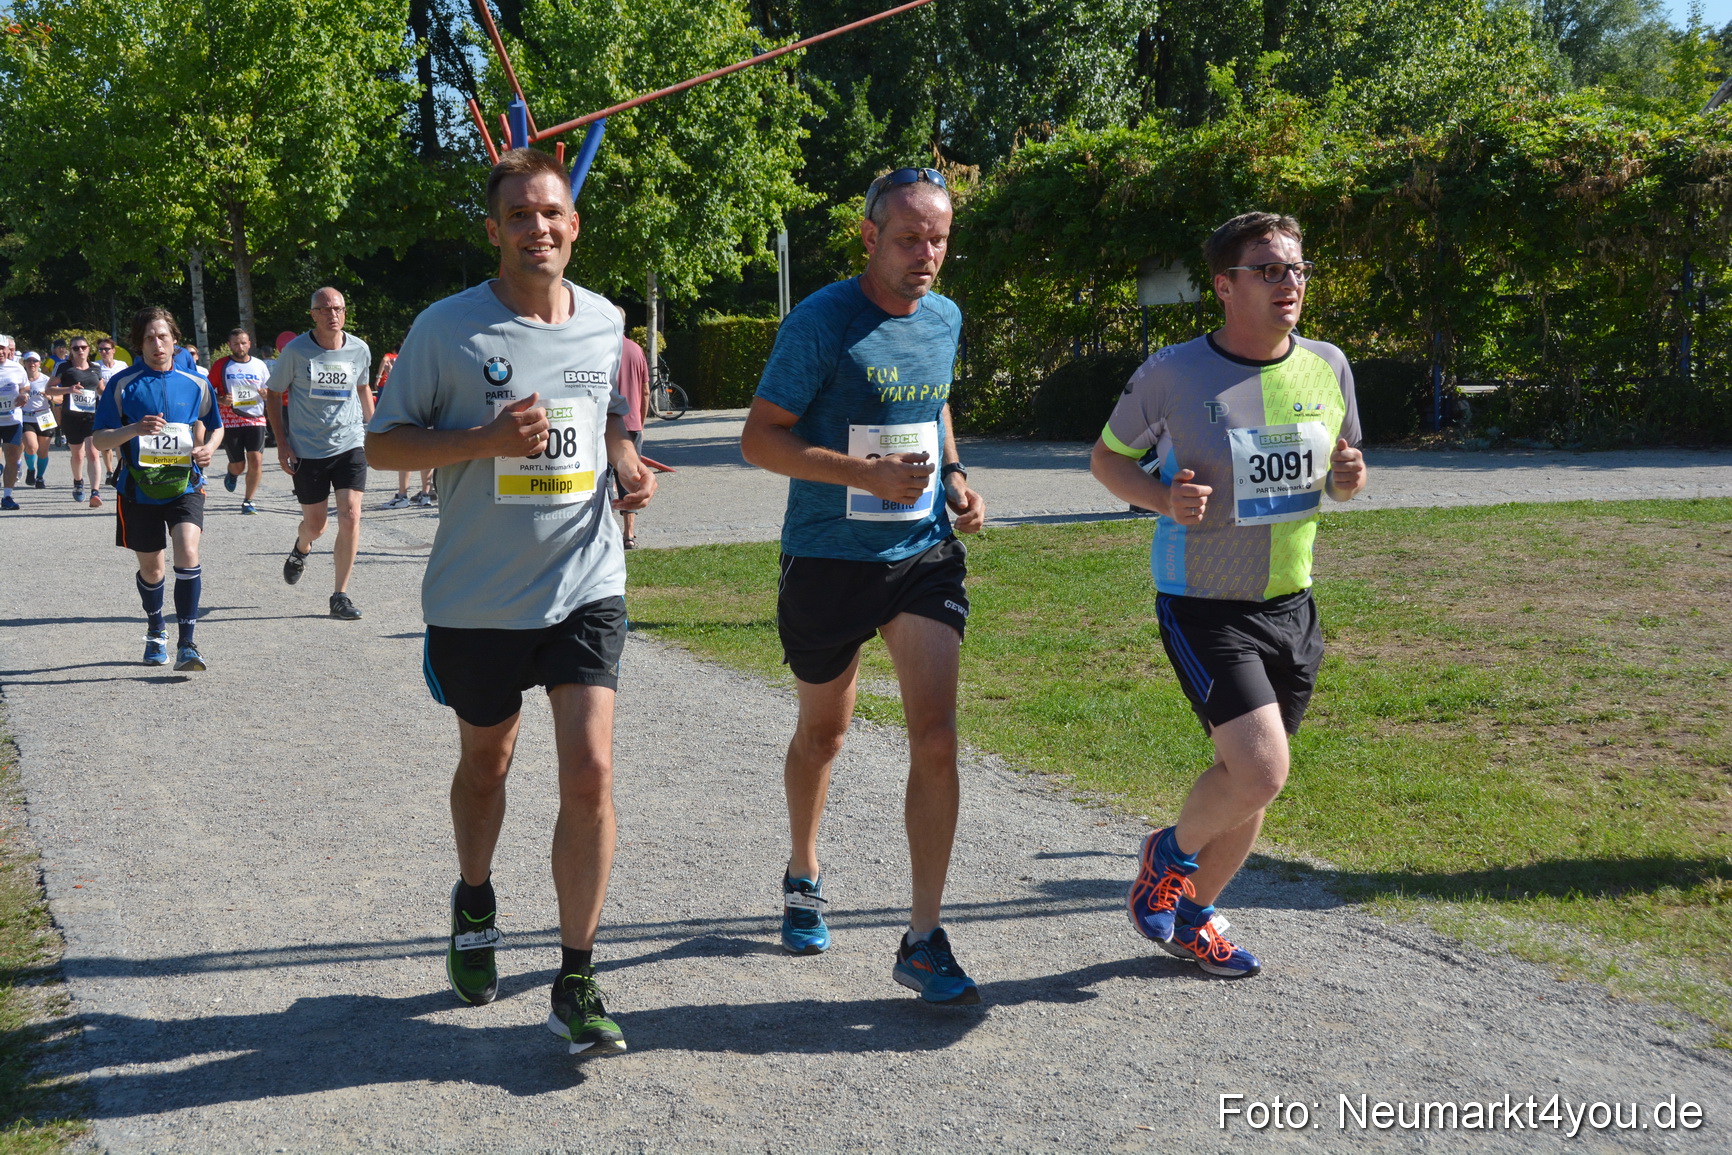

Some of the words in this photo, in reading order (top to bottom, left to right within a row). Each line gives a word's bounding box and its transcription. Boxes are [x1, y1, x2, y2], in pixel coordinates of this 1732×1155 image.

[318, 372, 347, 385] 2382
[564, 371, 608, 385] BOCK
[238, 391, 251, 399] 221
[485, 391, 516, 400] PARTL
[878, 386, 917, 402] YOUR
[546, 407, 573, 419] OCK
[153, 435, 178, 450] 121
[526, 426, 577, 460] 08
[880, 433, 919, 445] BOCK
[1259, 432, 1303, 445] BOCK
[545, 463, 573, 471] Neumarkt
[1249, 449, 1313, 484] 3091
[530, 478, 573, 494] Philipp
[533, 510, 579, 521] Stadtla
